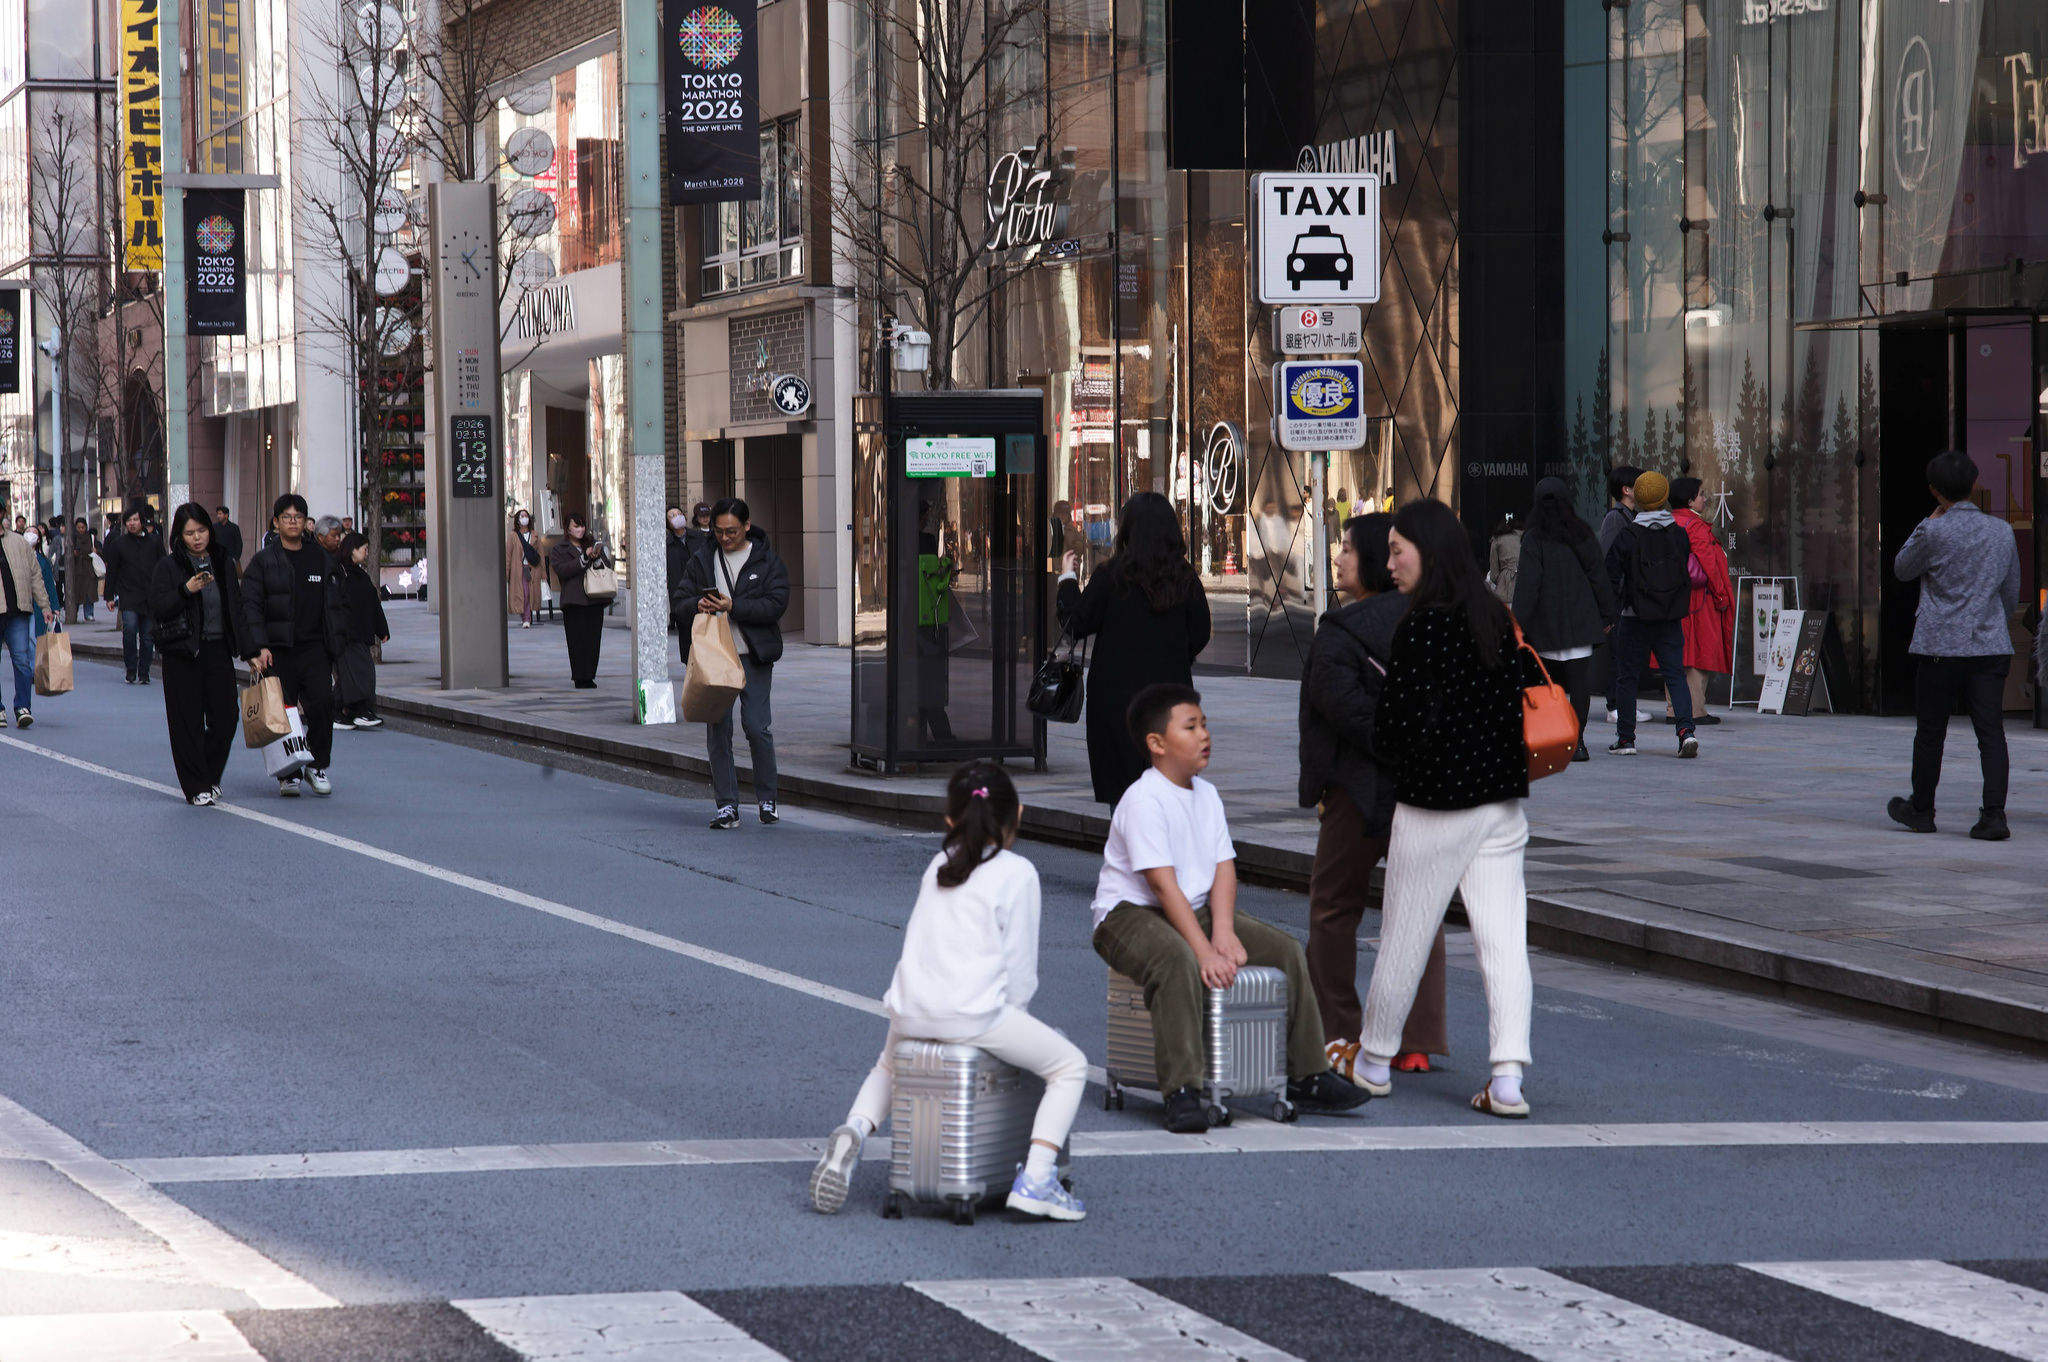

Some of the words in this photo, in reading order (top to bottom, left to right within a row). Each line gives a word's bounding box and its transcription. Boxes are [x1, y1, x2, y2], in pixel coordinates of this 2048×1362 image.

[681, 73, 743, 89] TOKYO
[682, 89, 742, 100] MARATHON
[682, 100, 743, 120] 2026
[1319, 129, 1398, 186] YAMAHA
[684, 181, 708, 189] March
[723, 178, 744, 186] 2026
[986, 148, 1059, 250] ReFa
[1273, 186, 1366, 216] TAXI
[197, 257, 235, 266] TOKYO
[197, 273, 235, 286] 2026
[518, 284, 574, 339] RIMOWA
[1285, 331, 1358, 349] 銀座ヤマハホール前
[1319, 368, 1345, 380] SERVICE
[1300, 381, 1345, 408] 優良
[466, 400, 480, 408] SAT
[456, 420, 484, 429] 2026
[455, 430, 486, 439] 02.15
[458, 441, 487, 461] 13
[456, 463, 488, 483] 24
[1482, 462, 1529, 477] YAMAHA
[473, 484, 486, 495] 13
[246, 703, 260, 718] GU
[282, 735, 310, 757] NIK
